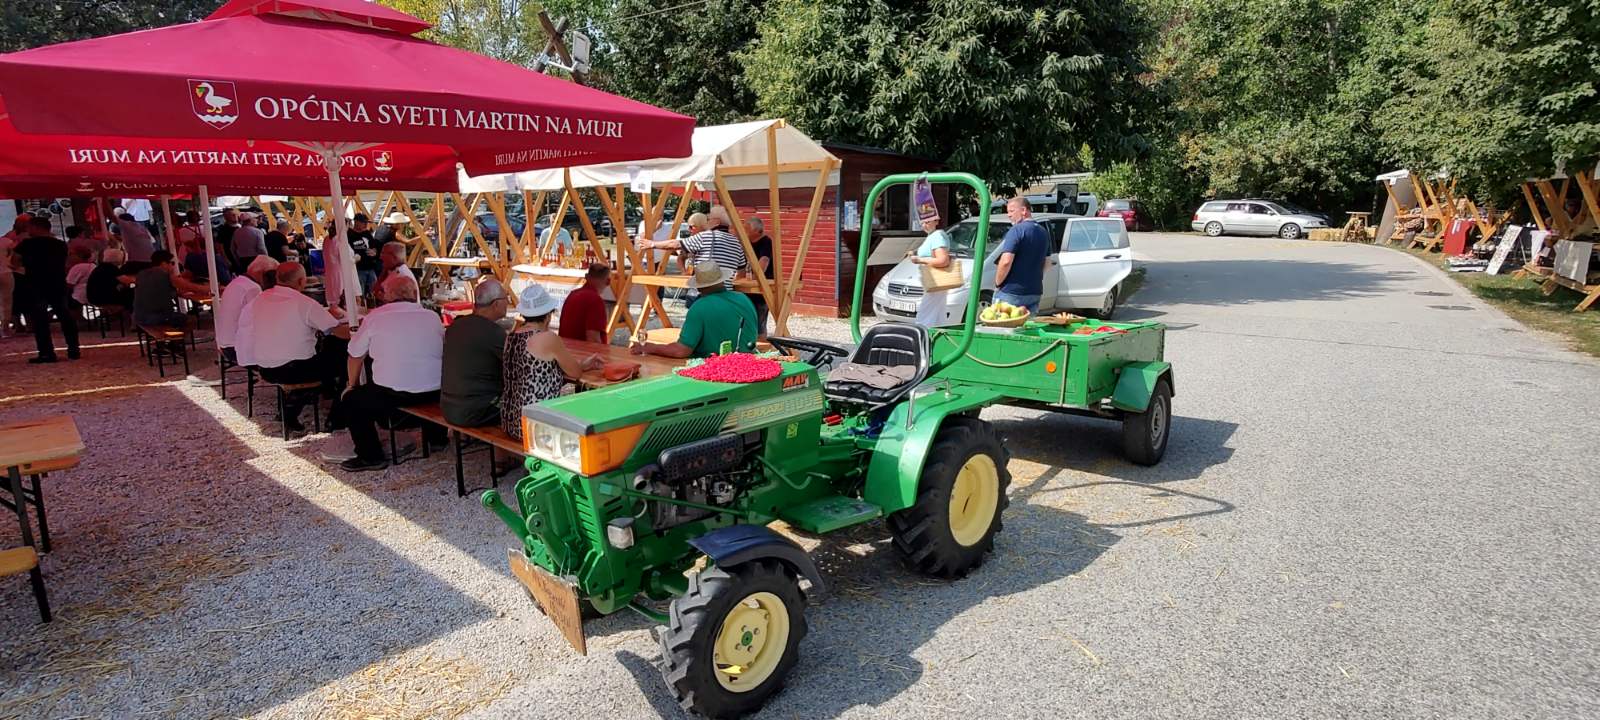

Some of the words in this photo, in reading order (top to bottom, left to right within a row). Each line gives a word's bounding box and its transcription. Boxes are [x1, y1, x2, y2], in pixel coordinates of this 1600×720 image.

[254, 95, 372, 124] OPĆINA
[378, 104, 448, 127] SVETI
[454, 109, 540, 133] MARTIN
[545, 116, 572, 135] NA
[577, 118, 623, 138] MURI
